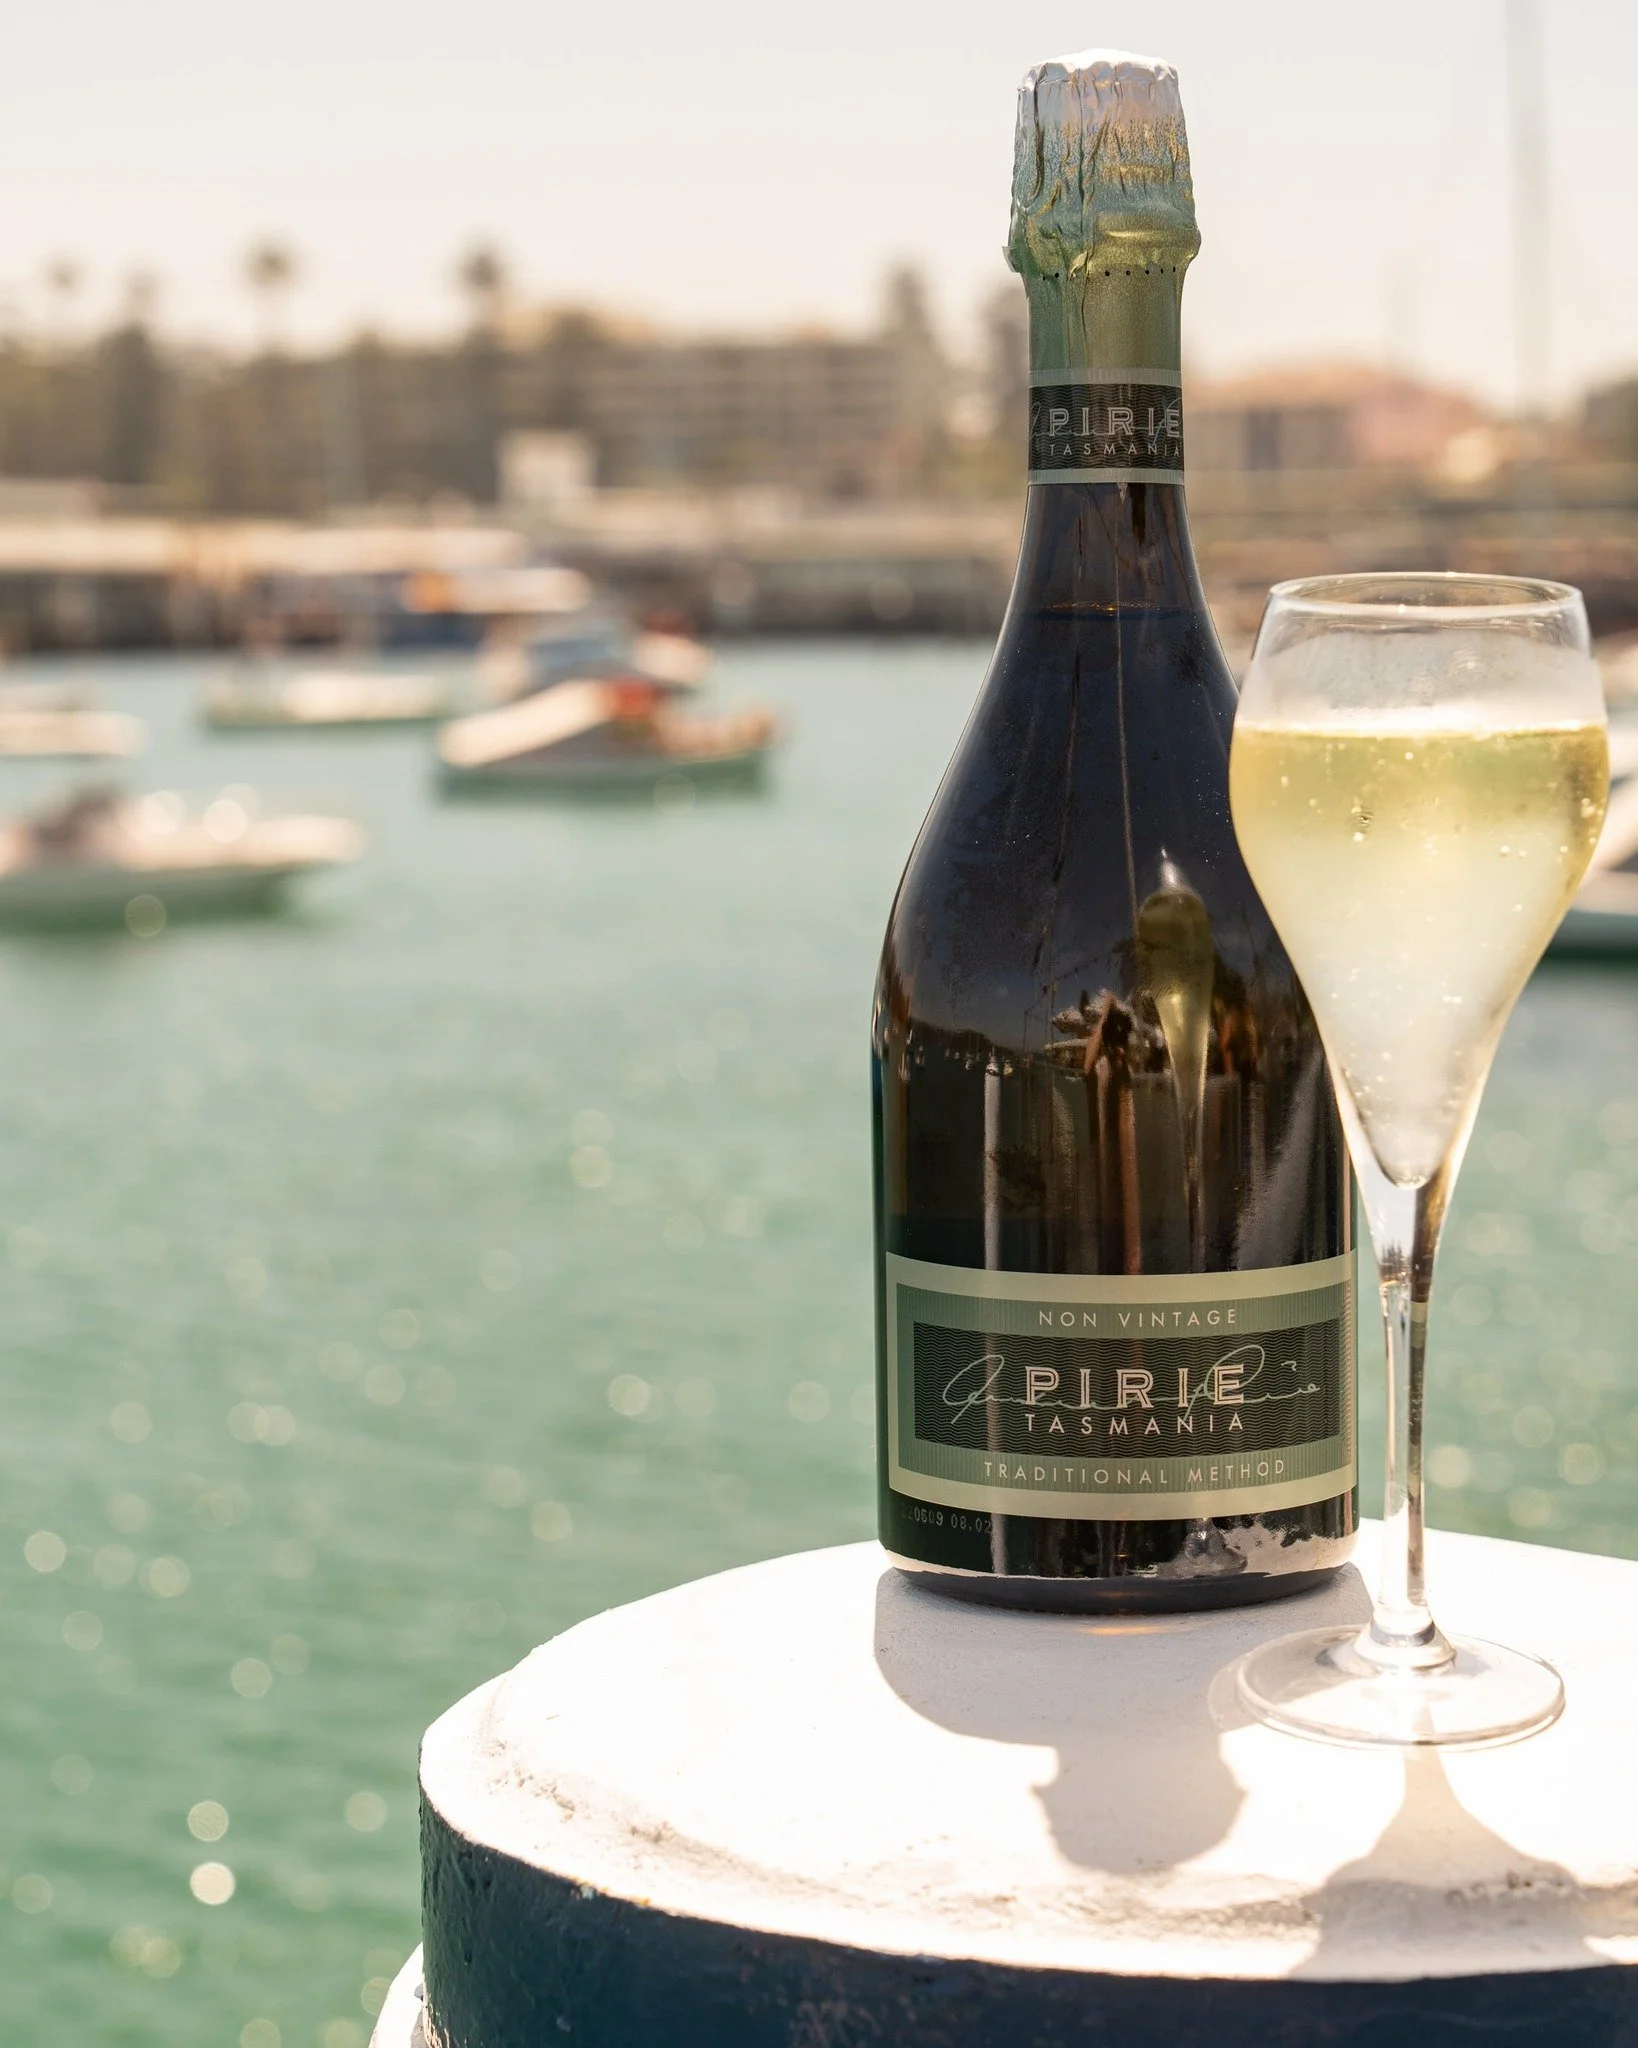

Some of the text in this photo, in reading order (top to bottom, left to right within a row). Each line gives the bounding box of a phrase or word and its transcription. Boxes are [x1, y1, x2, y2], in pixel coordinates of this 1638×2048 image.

[1049, 406, 1181, 438] PIRIE
[1049, 443, 1180, 457] TASMANIA
[1039, 1309, 1237, 1329] NON VINTAGE
[1025, 1363, 1244, 1409] PIRIE
[1024, 1412, 1244, 1436] TASMANIA
[984, 1459, 1285, 1485] TRADITIONAL METHOD
